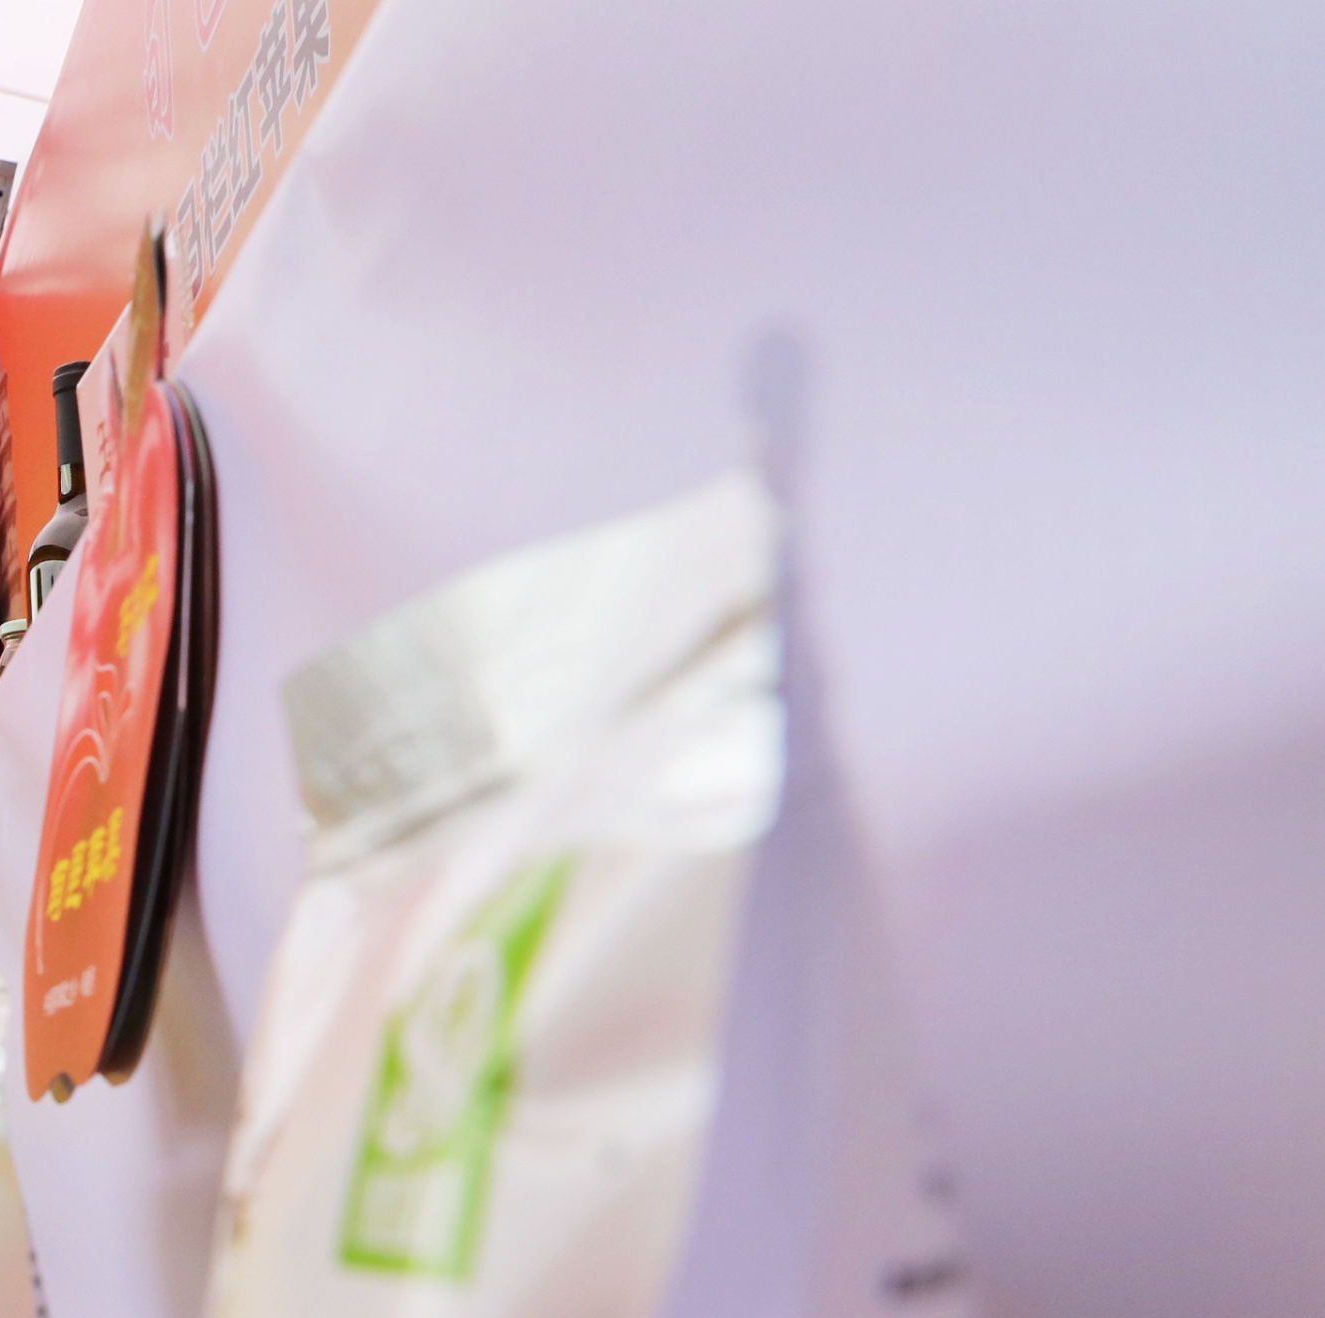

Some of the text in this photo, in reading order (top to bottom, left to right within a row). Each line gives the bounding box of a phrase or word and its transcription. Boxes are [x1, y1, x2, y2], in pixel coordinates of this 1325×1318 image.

[176, 0, 329, 301] 马栏红苹果
